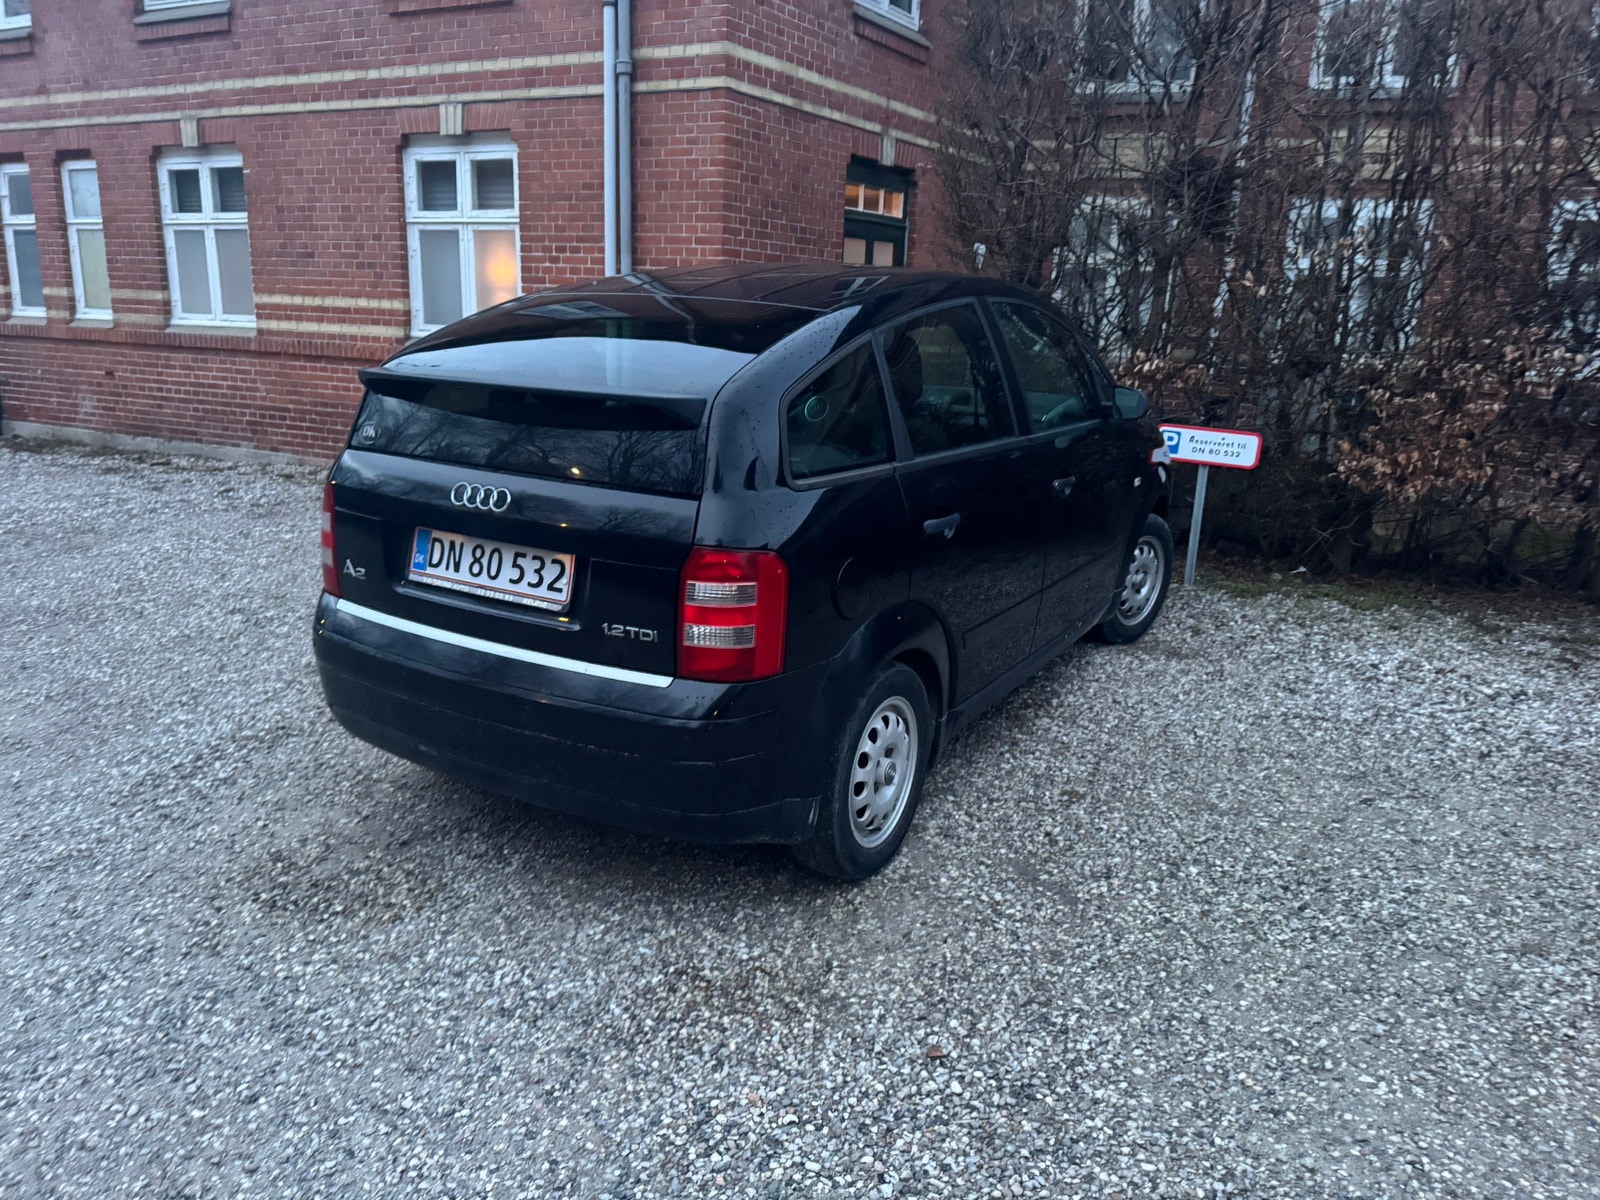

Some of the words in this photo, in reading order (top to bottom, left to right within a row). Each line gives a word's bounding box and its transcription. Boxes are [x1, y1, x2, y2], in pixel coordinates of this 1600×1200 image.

[1163, 432, 1179, 448] P
[1189, 435, 1235, 448] Reserveret
[1237, 442, 1248, 450] til
[1192, 446, 1205, 454] DN
[1208, 448, 1220, 456] 80
[1223, 449, 1241, 458] 532
[414, 553, 425, 564] DK
[428, 537, 464, 573] DN
[468, 544, 503, 580] 80
[508, 551, 567, 593] 532
[343, 559, 366, 580] A2
